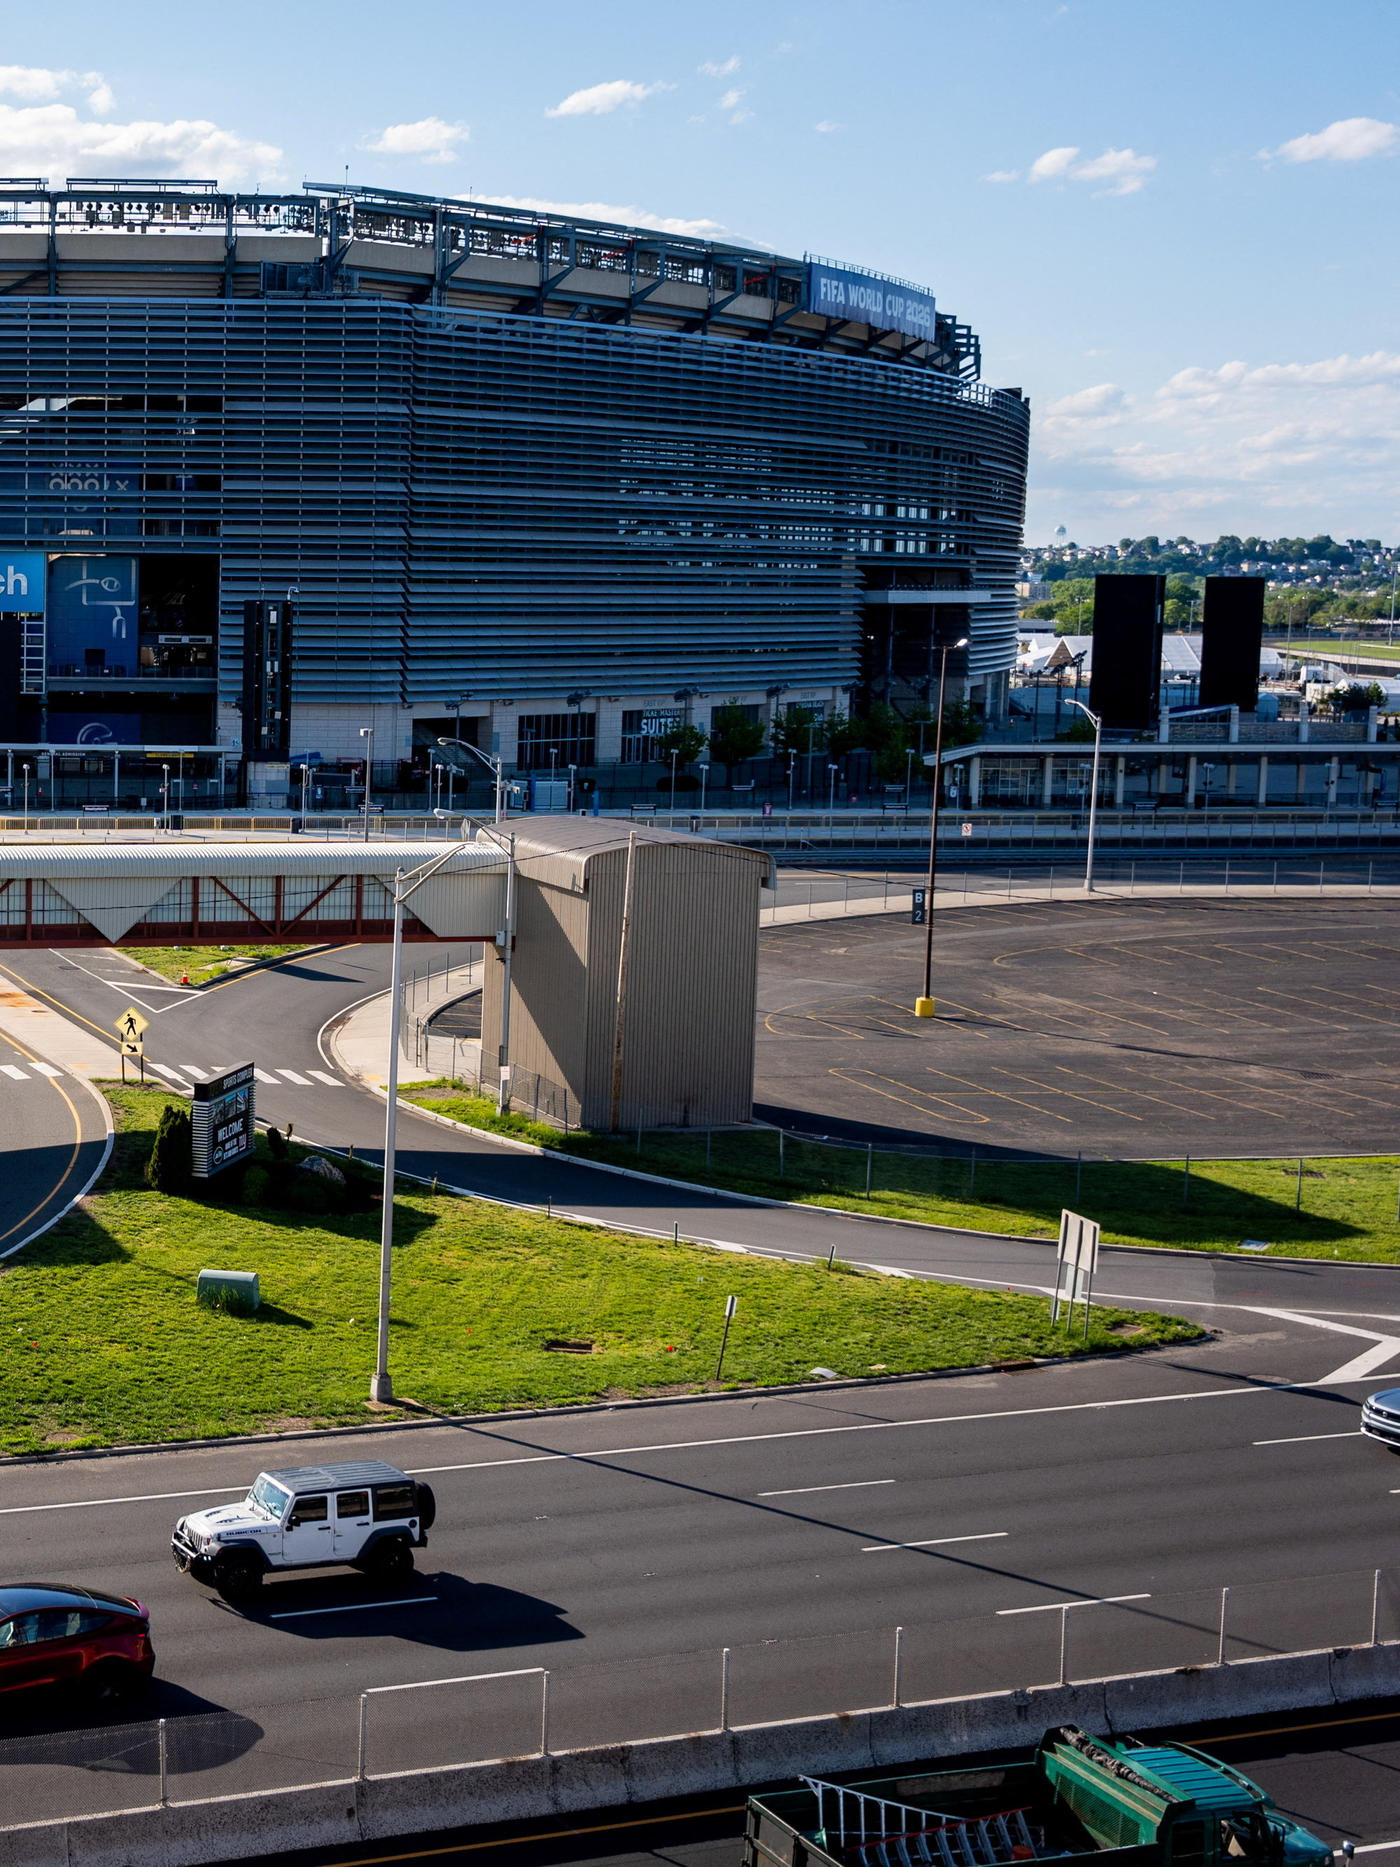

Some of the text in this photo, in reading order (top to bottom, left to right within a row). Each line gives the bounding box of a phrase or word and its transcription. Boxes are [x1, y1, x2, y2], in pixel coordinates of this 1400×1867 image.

[820, 277, 931, 328] FIFA WORLD CUP 2026
[915, 892, 924, 903] B
[914, 910, 922, 921] 2
[217, 1118, 243, 1142] WELCOME
